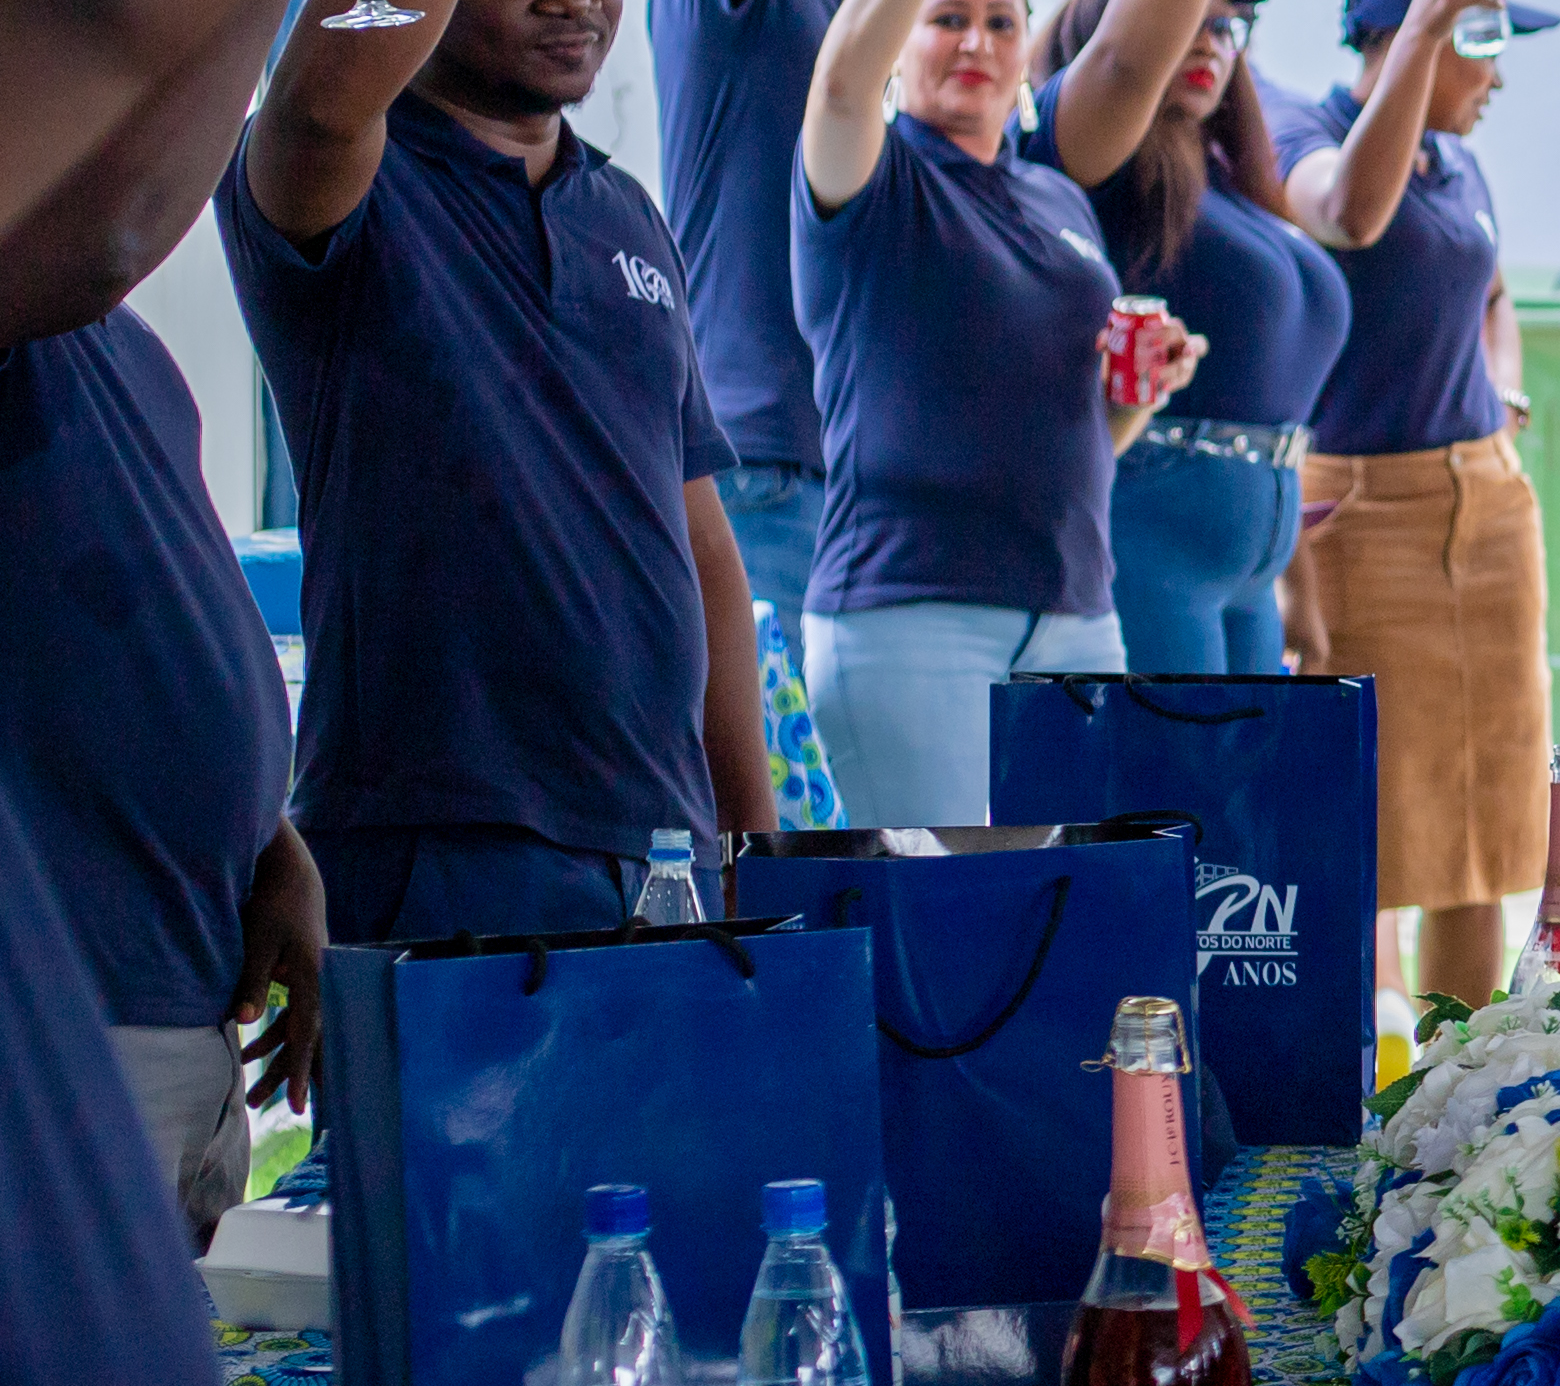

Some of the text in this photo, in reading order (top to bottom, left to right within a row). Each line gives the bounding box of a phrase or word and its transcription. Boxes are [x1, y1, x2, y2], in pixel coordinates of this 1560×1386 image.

[1222, 937, 1242, 949] DO
[1245, 936, 1291, 949] NORTE
[1223, 961, 1297, 986] ANOS
